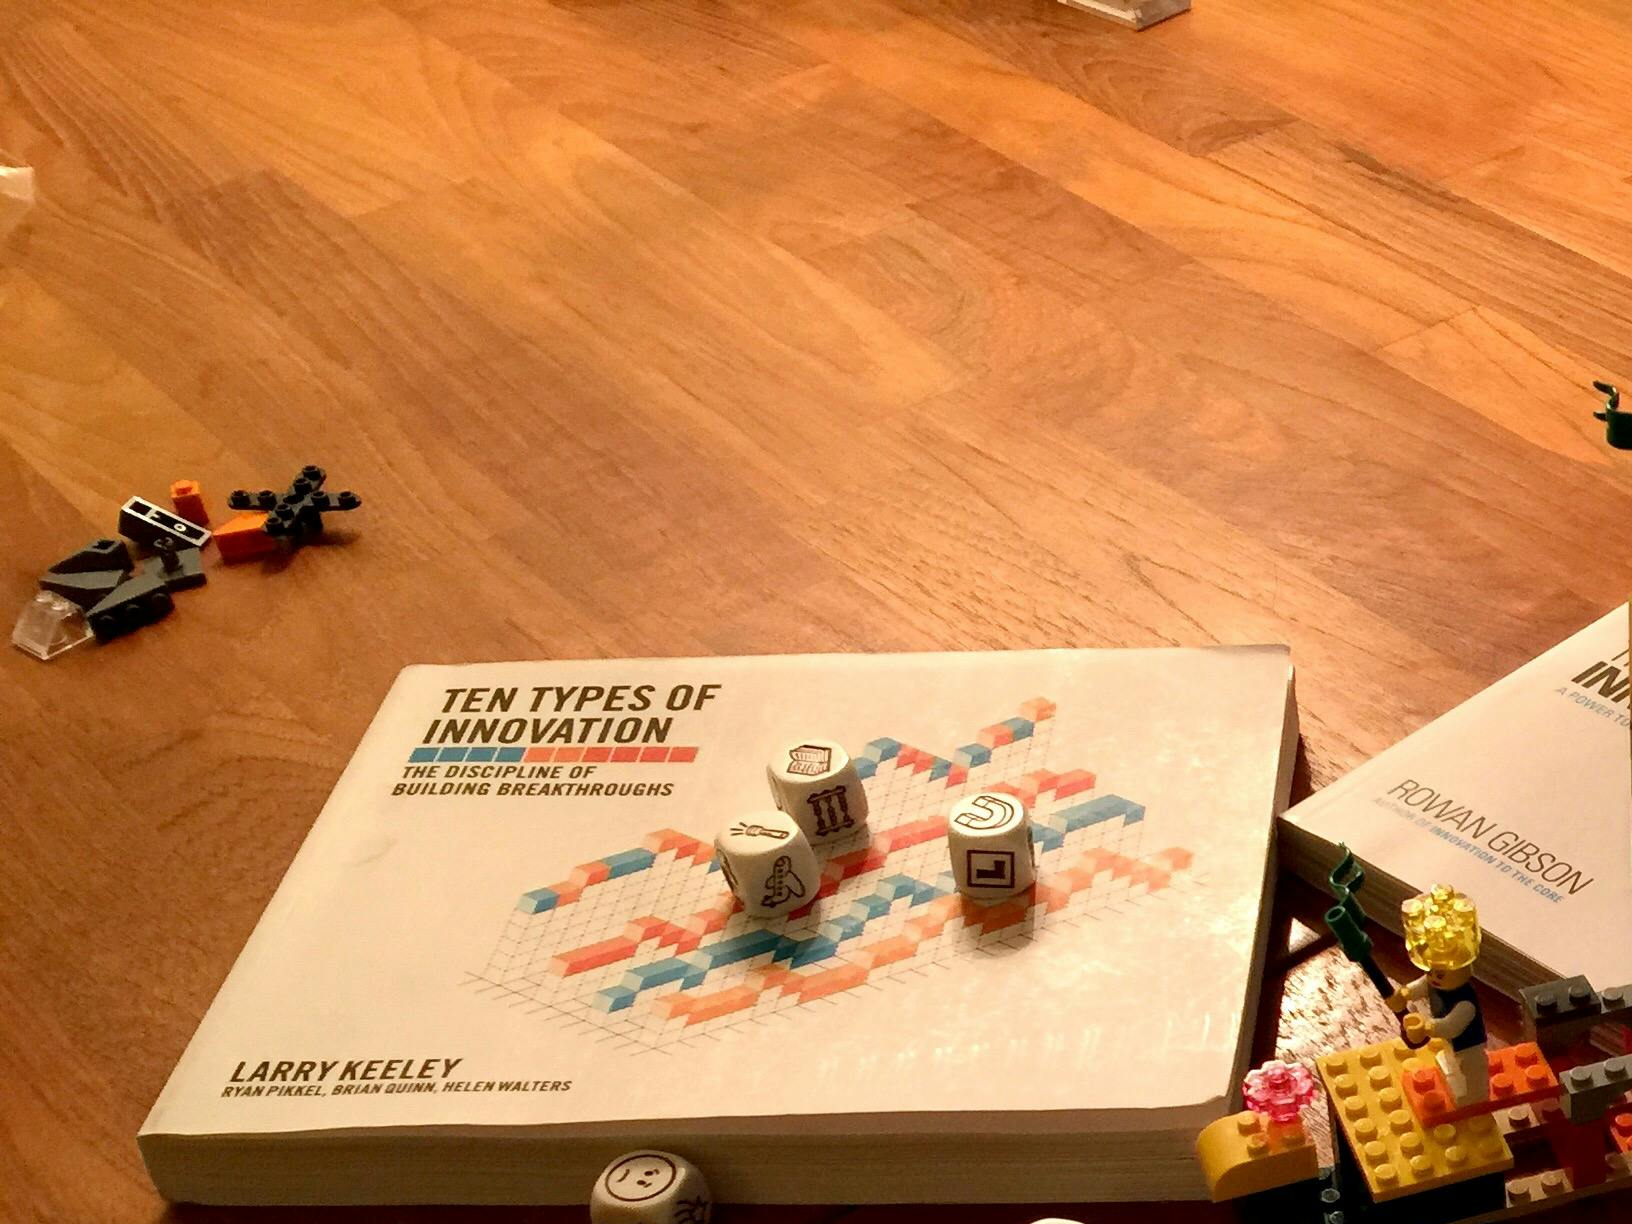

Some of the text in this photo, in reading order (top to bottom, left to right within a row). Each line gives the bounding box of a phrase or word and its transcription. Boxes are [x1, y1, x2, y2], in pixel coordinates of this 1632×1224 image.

[440, 684, 722, 713] TEN TYPES OF
[1569, 691, 1614, 718] POWER
[423, 717, 673, 744] INNOVATION
[402, 765, 597, 779] THE DISCIPLINE OF
[391, 782, 674, 797] BUILDING BREAKTHROUGHS
[1387, 779, 1594, 895] ROWAN GIBSON
[1429, 826, 1497, 864] INNOVATION
[1495, 858, 1512, 873] TO
[1511, 869, 1533, 887] THE
[1532, 883, 1565, 904] CORE
[230, 1058, 464, 1083] LARRY KEELEY
[221, 1080, 573, 1098] RYAN PIKKEL, BRIAN QUINN, HELEN WALTERS
